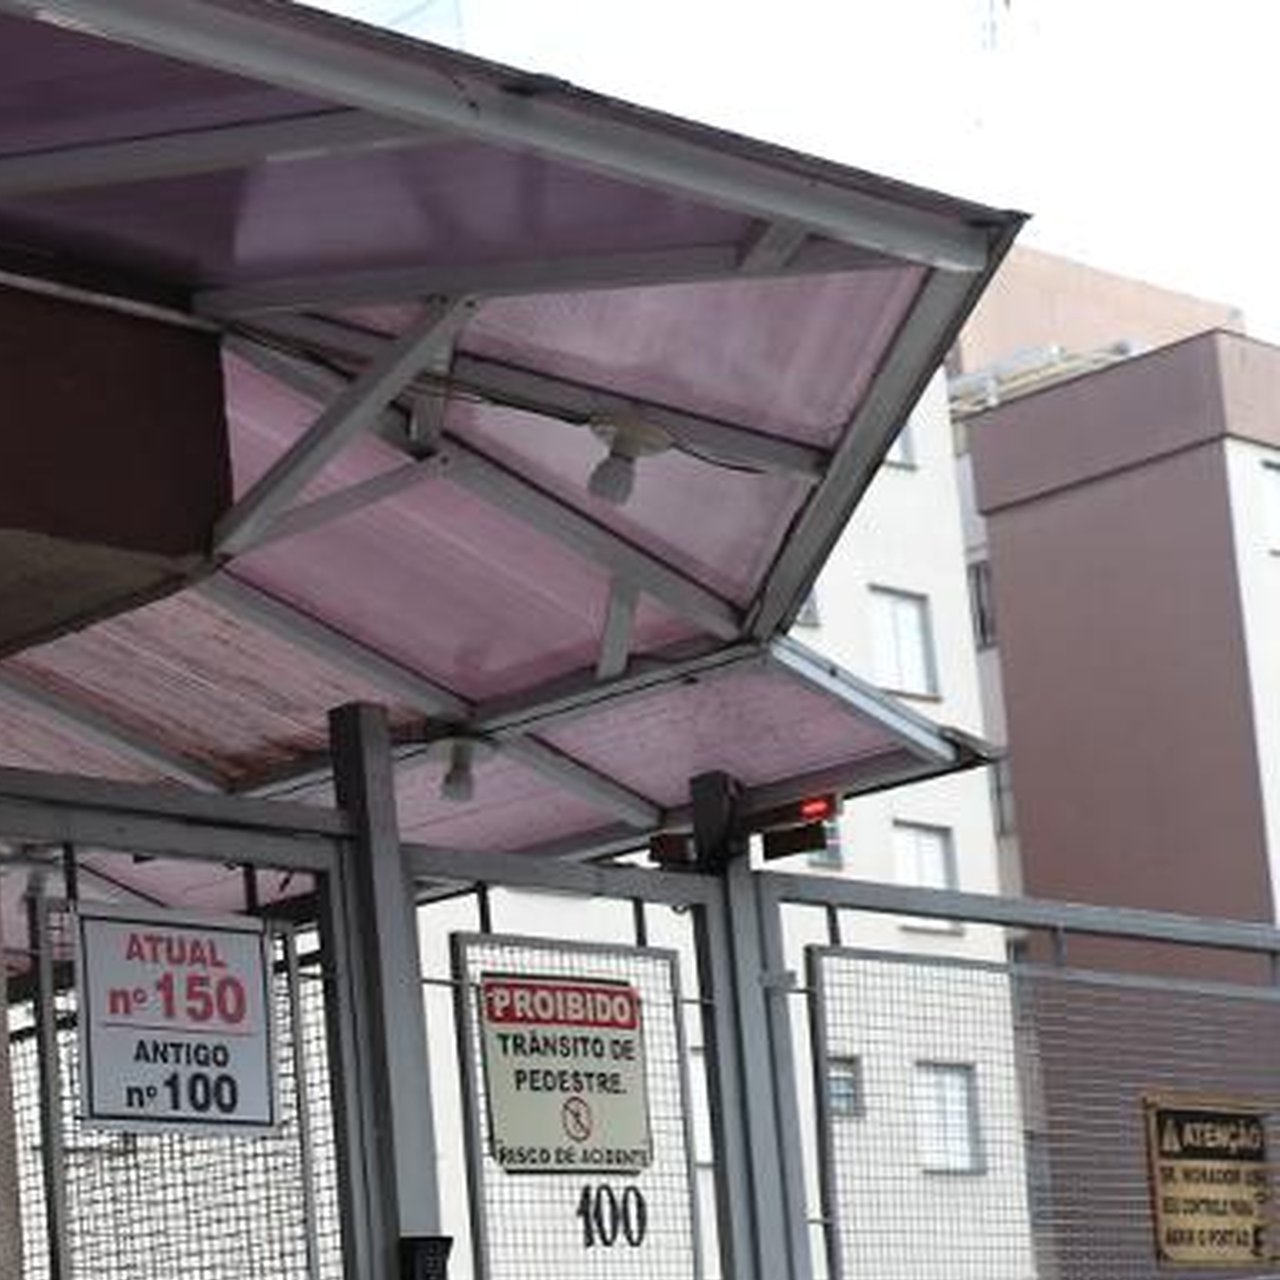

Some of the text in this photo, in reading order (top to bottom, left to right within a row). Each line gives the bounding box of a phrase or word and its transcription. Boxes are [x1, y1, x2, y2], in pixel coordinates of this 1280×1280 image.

[125, 933, 227, 968] ATUAL
[157, 972, 246, 1024] 150
[493, 987, 632, 1022] PROIBIDO
[134, 1040, 229, 1068] ANTIGO
[611, 1041, 635, 1061] DE
[164, 1072, 238, 1113] 100
[1183, 1121, 1263, 1153] ATENÇÃO
[576, 1184, 648, 1248] 100
